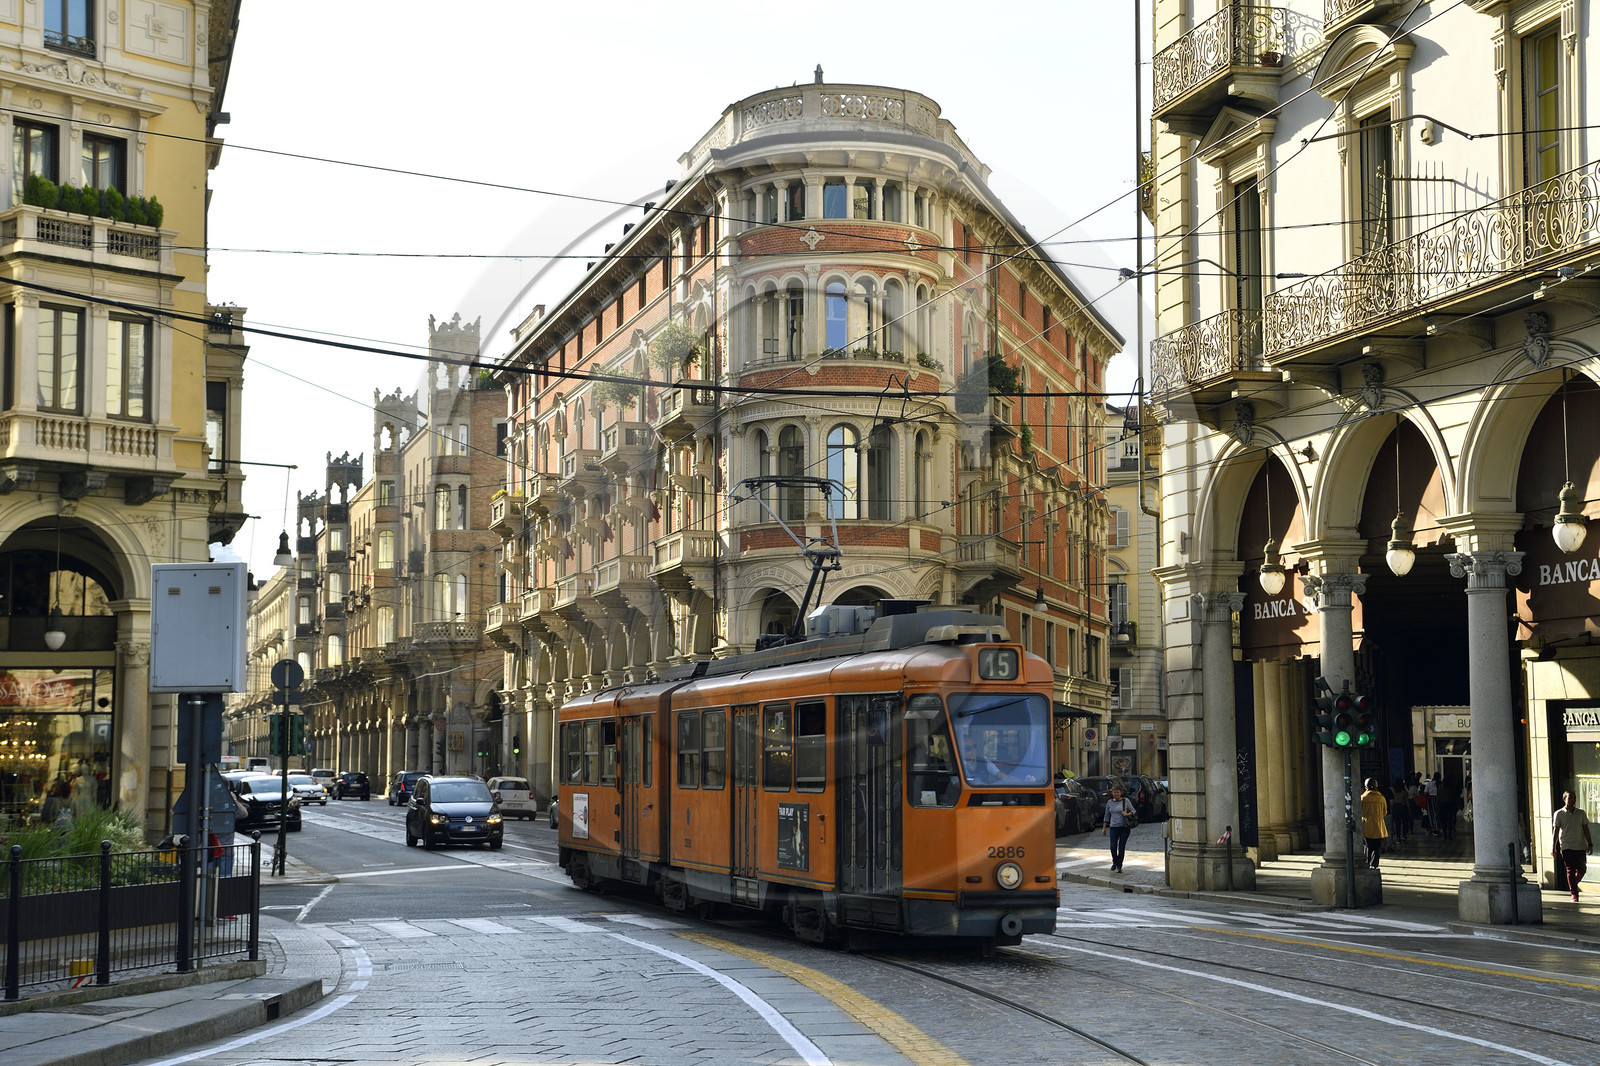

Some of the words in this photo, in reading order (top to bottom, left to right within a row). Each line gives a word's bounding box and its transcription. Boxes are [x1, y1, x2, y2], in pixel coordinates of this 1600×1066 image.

[1539, 558, 1600, 586] BANCA
[1254, 598, 1296, 620] BANCA
[986, 652, 1009, 677] 15
[987, 846, 1025, 858] 2886
